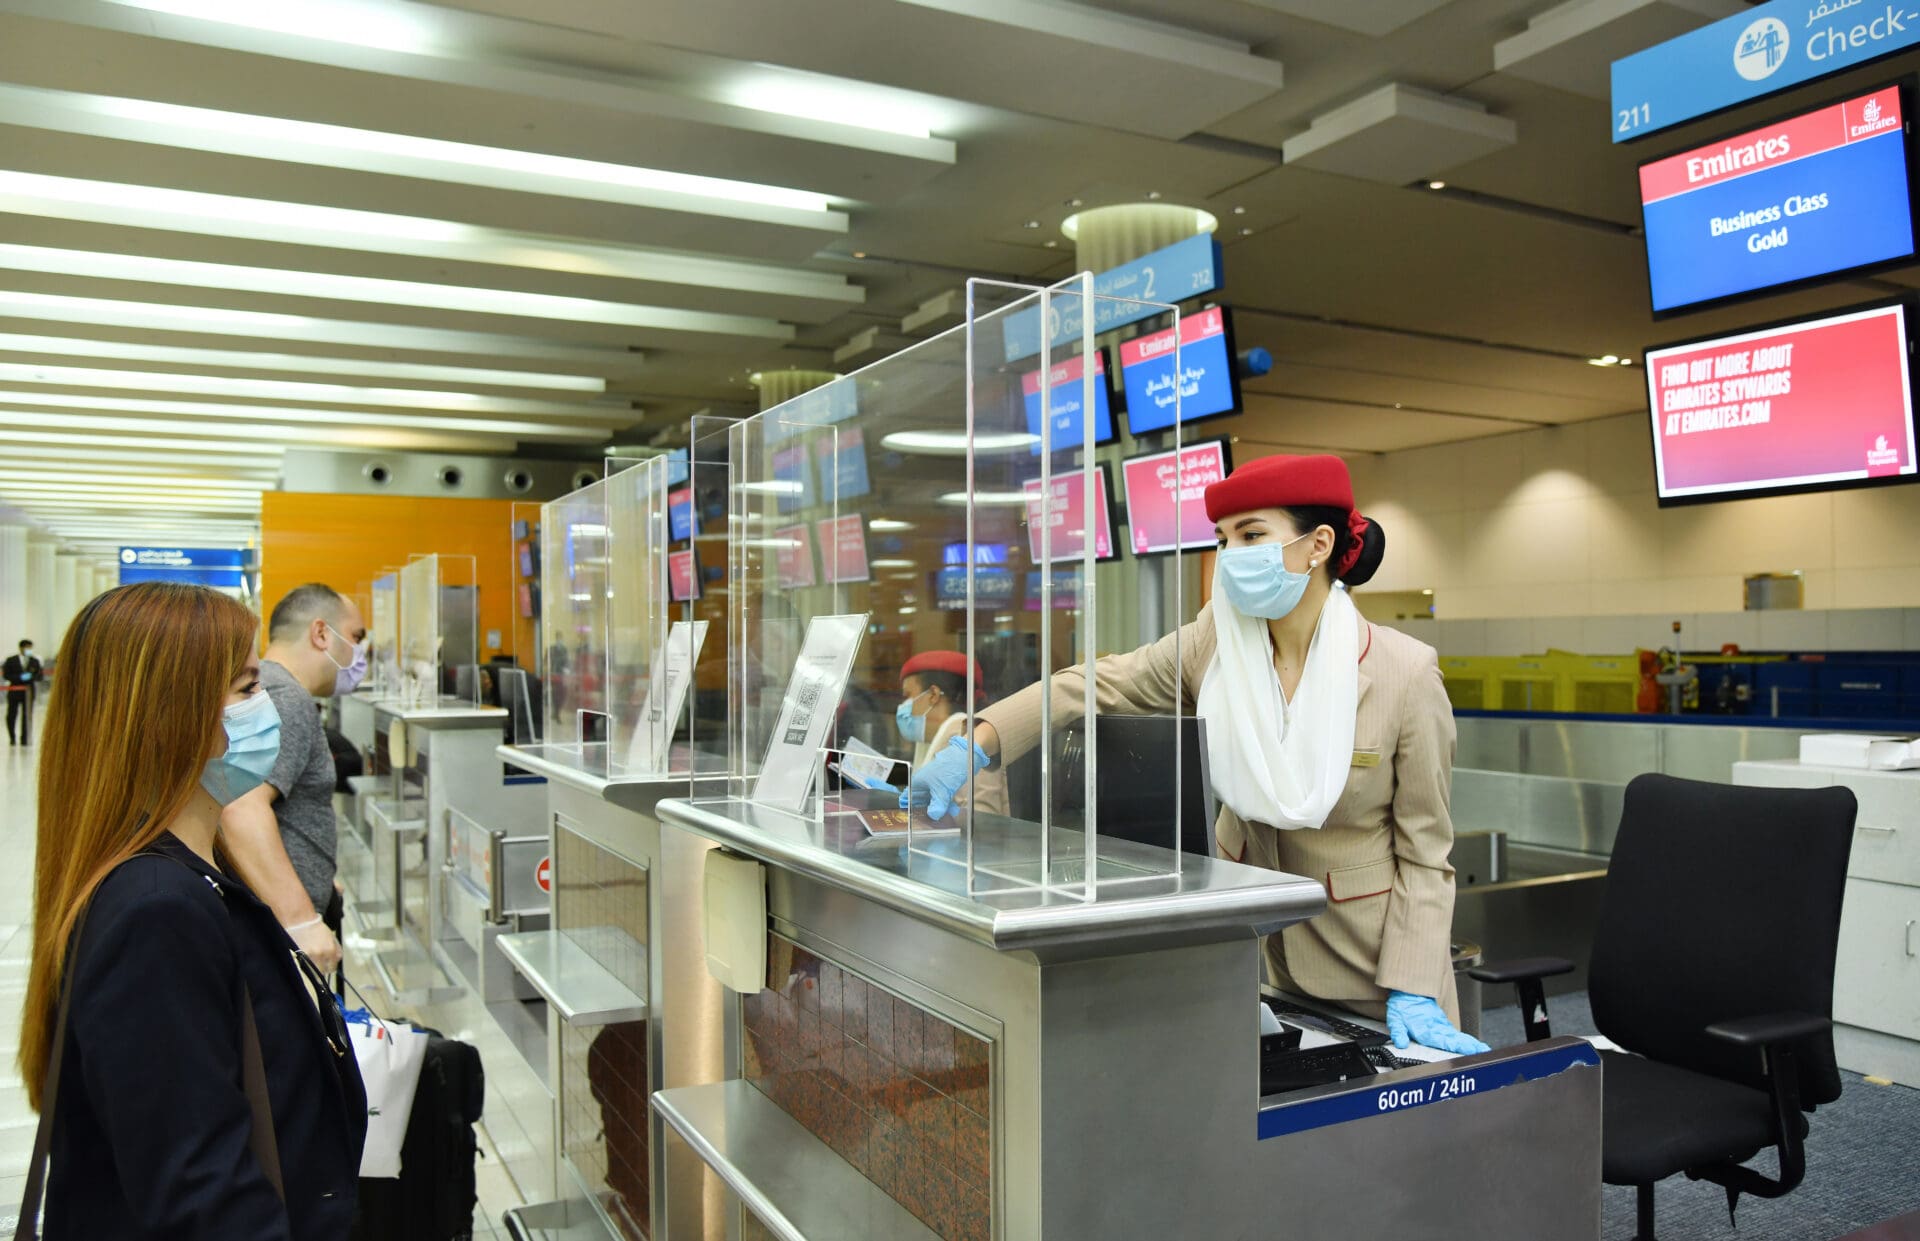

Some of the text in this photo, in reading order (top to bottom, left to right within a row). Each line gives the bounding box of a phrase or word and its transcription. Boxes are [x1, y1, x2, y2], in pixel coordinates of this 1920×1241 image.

[1618, 102, 1650, 133] 211
[1852, 116, 1897, 137] Emirates
[1686, 134, 1790, 183] Emirates
[1710, 192, 1829, 237] Business Class
[1747, 226, 1789, 253] Gold
[1142, 267, 1157, 299] 2
[1191, 269, 1212, 289] 212
[1661, 343, 1794, 388] FIND OUT MORE ABOUT
[1663, 370, 1791, 412] EMIRATES SKYWARDS
[1665, 399, 1771, 436] AT EMIRATES.COM
[1427, 1081, 1437, 1101] /
